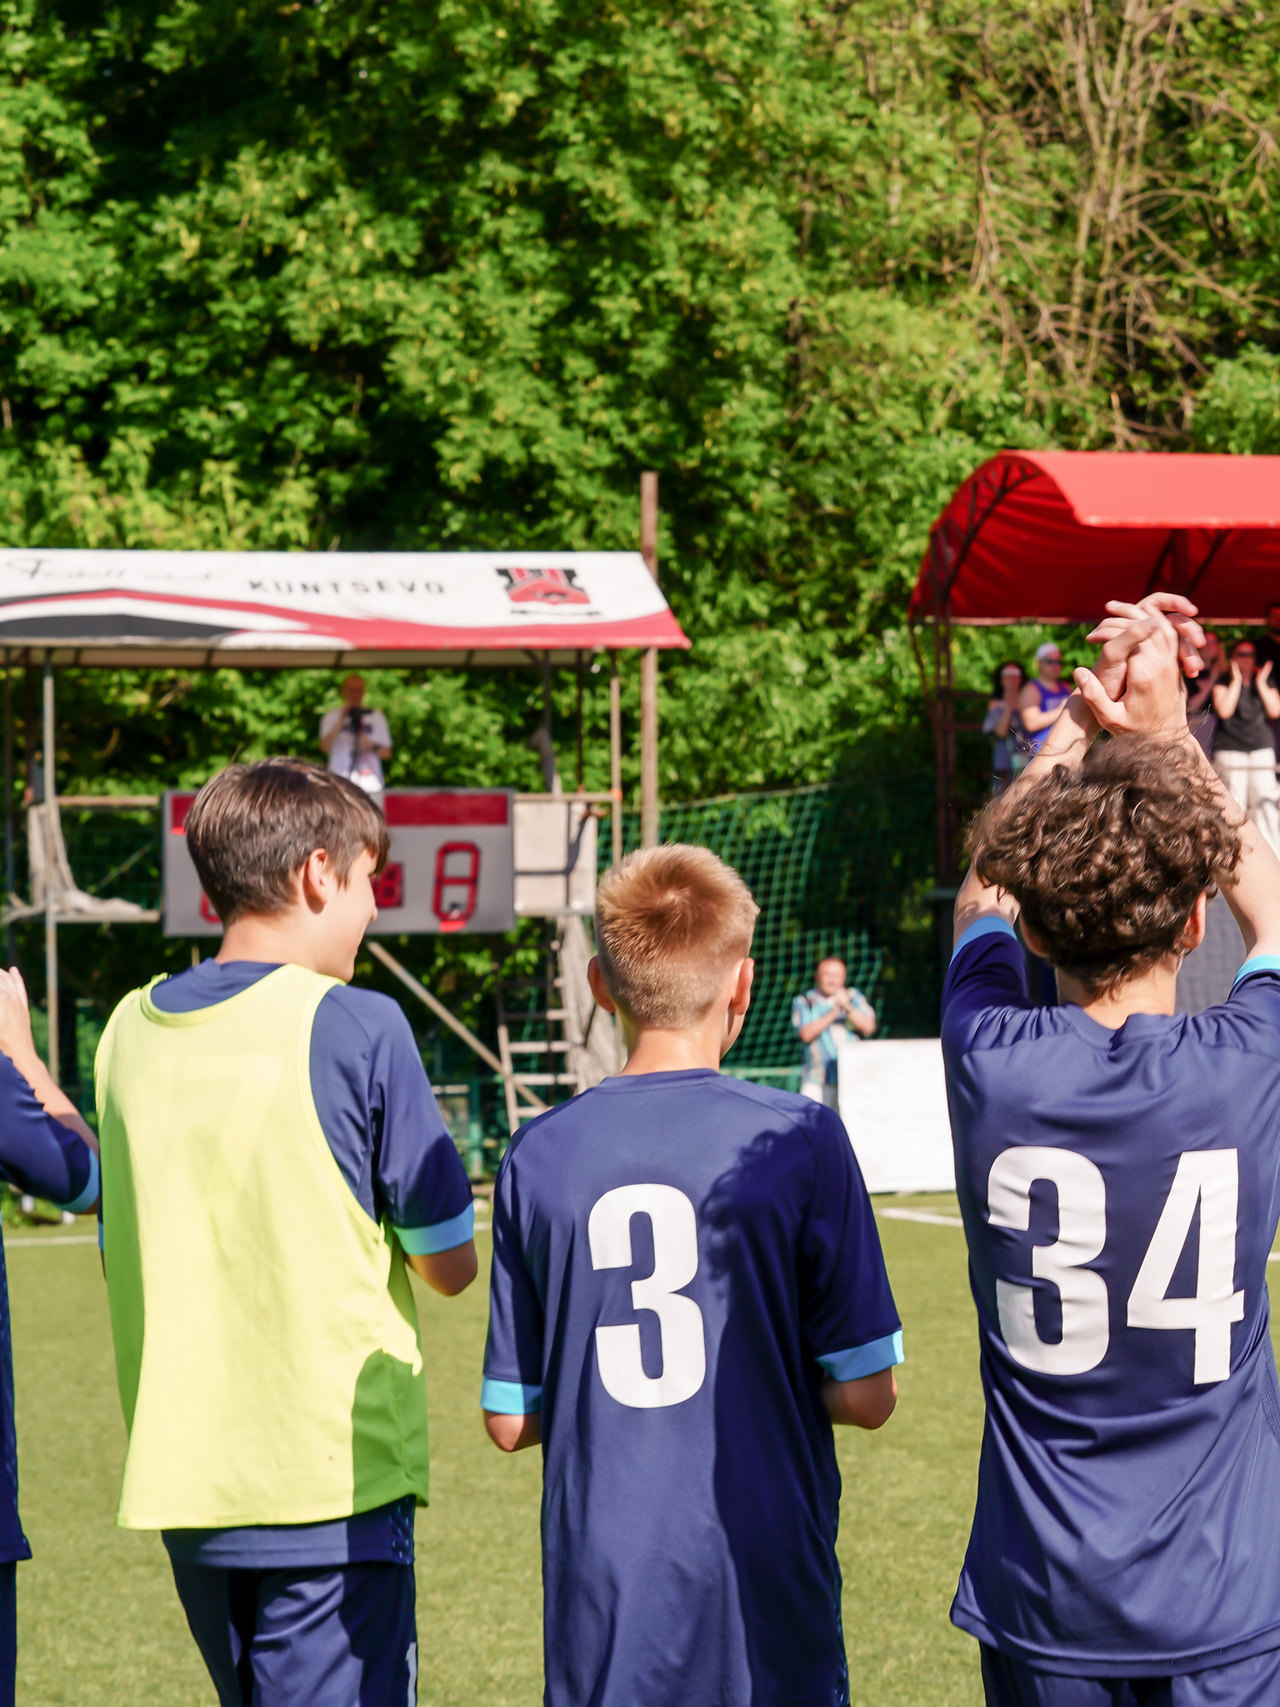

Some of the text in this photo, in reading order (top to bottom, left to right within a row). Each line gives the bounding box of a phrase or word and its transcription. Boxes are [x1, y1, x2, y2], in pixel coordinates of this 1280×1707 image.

[249, 579, 444, 595] KUNTSEVO
[588, 1183, 706, 1409] 3
[988, 1146, 1245, 1385] 34
